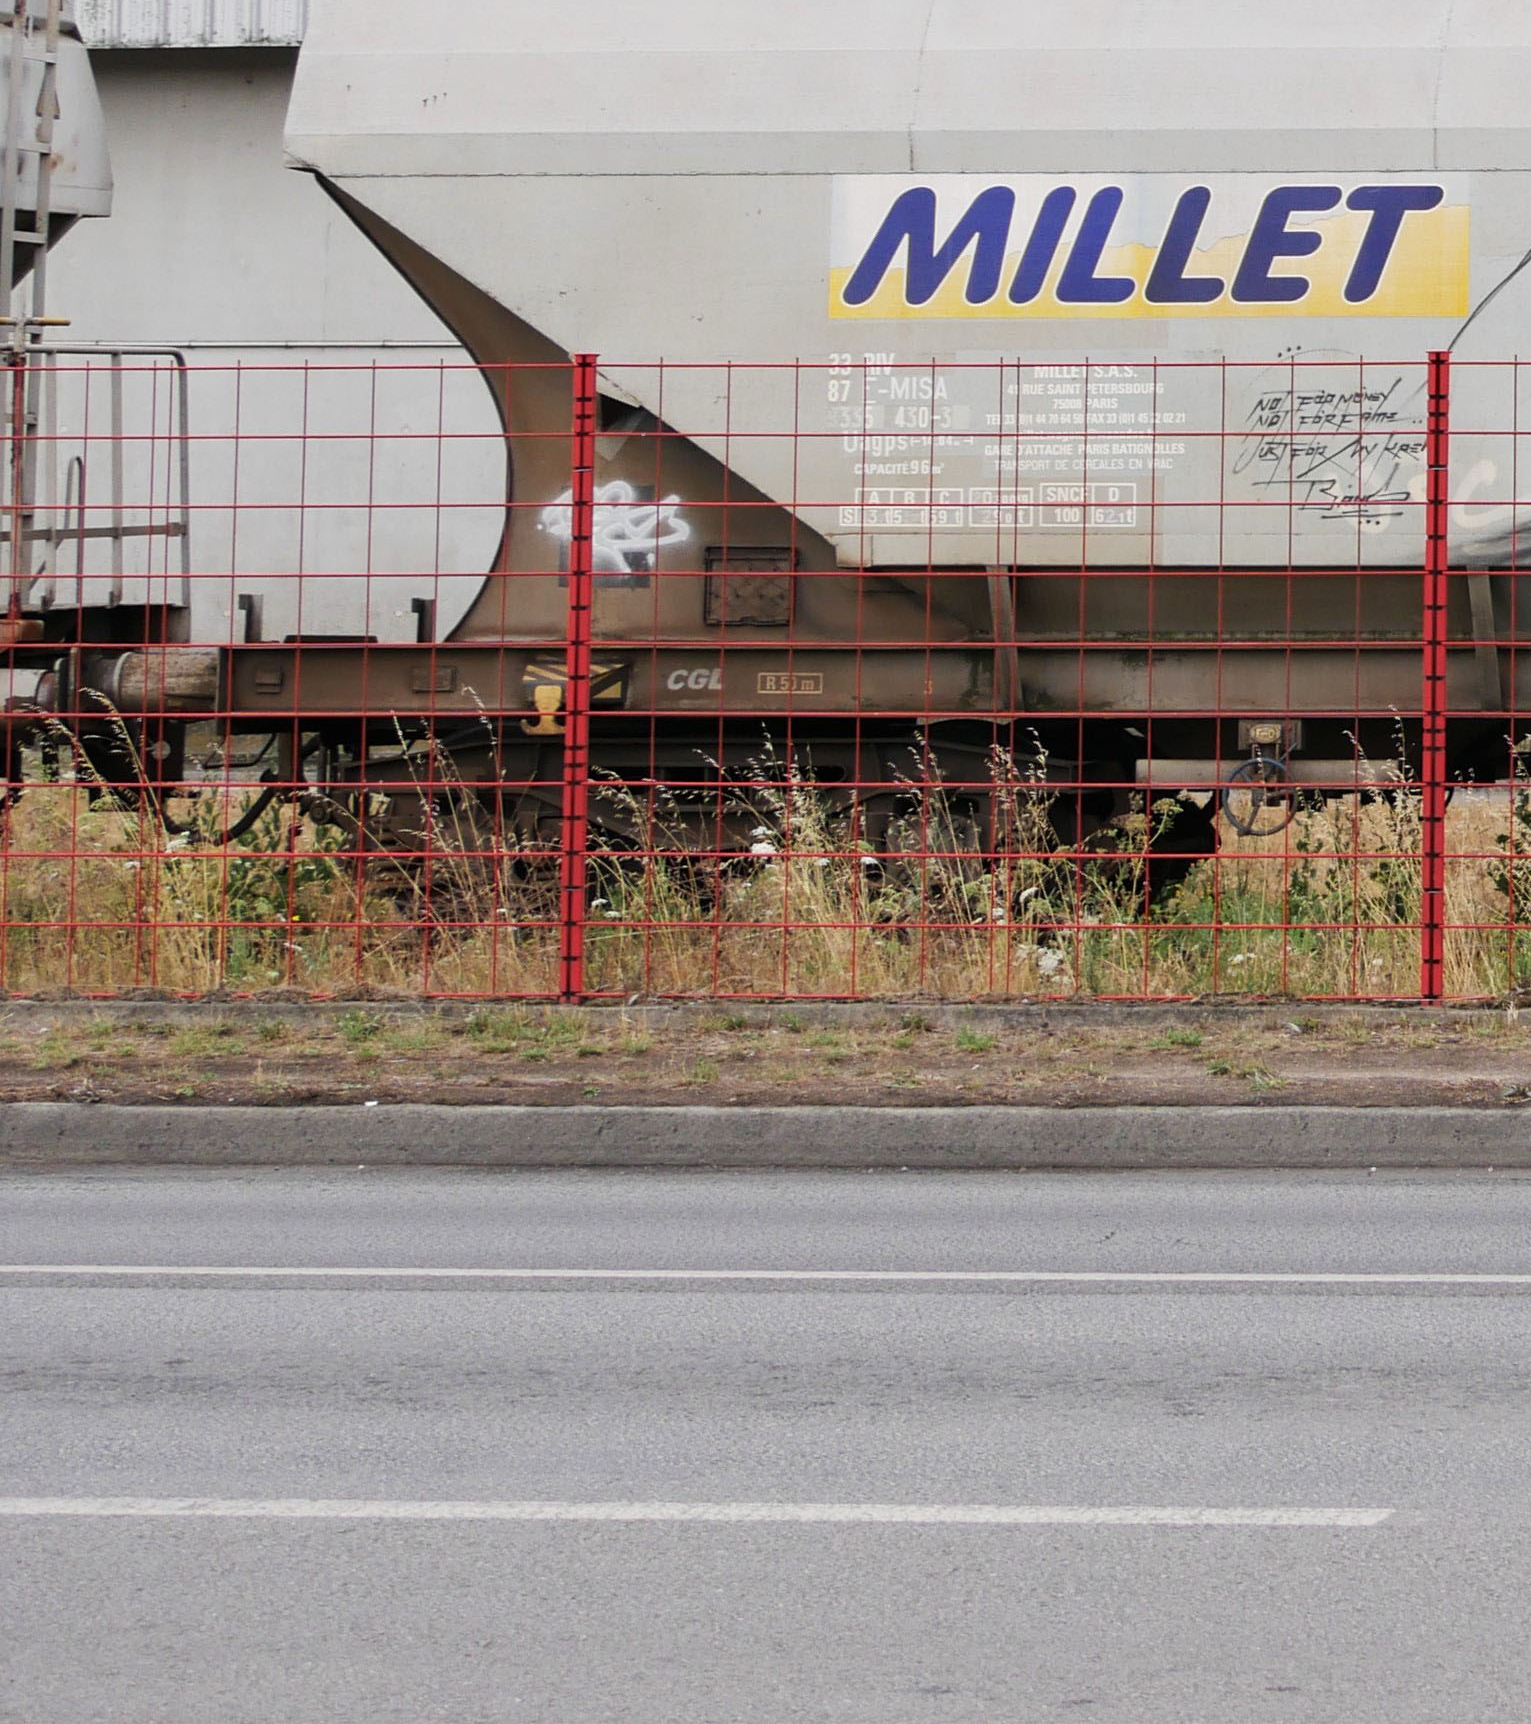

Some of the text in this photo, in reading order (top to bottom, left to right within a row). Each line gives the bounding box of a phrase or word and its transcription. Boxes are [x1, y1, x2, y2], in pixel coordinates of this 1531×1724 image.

[842, 185, 1445, 305] MILLET
[828, 352, 896, 376] 33 RIV
[828, 379, 851, 402] 87
[1022, 383, 1045, 395] RUE
[1047, 383, 1081, 395] SAINT
[1086, 397, 1119, 409] PARIS
[1086, 412, 1105, 425] FAX
[1078, 443, 1110, 455] PARIS
[1112, 443, 1186, 455] BATIGNOLLES
[909, 459, 930, 475] 96
[993, 459, 1051, 471] TRANSPORT
[1055, 459, 1069, 470] DE
[1128, 458, 1143, 469] EN
[868, 491, 880, 505] A
[903, 491, 915, 505] B
[940, 491, 951, 505] C
[1108, 487, 1120, 502] D
[843, 508, 854, 524] S
[1055, 507, 1081, 523] 100
[666, 667, 723, 691] CGL
[766, 676, 777, 691] R
[801, 679, 815, 691] m
